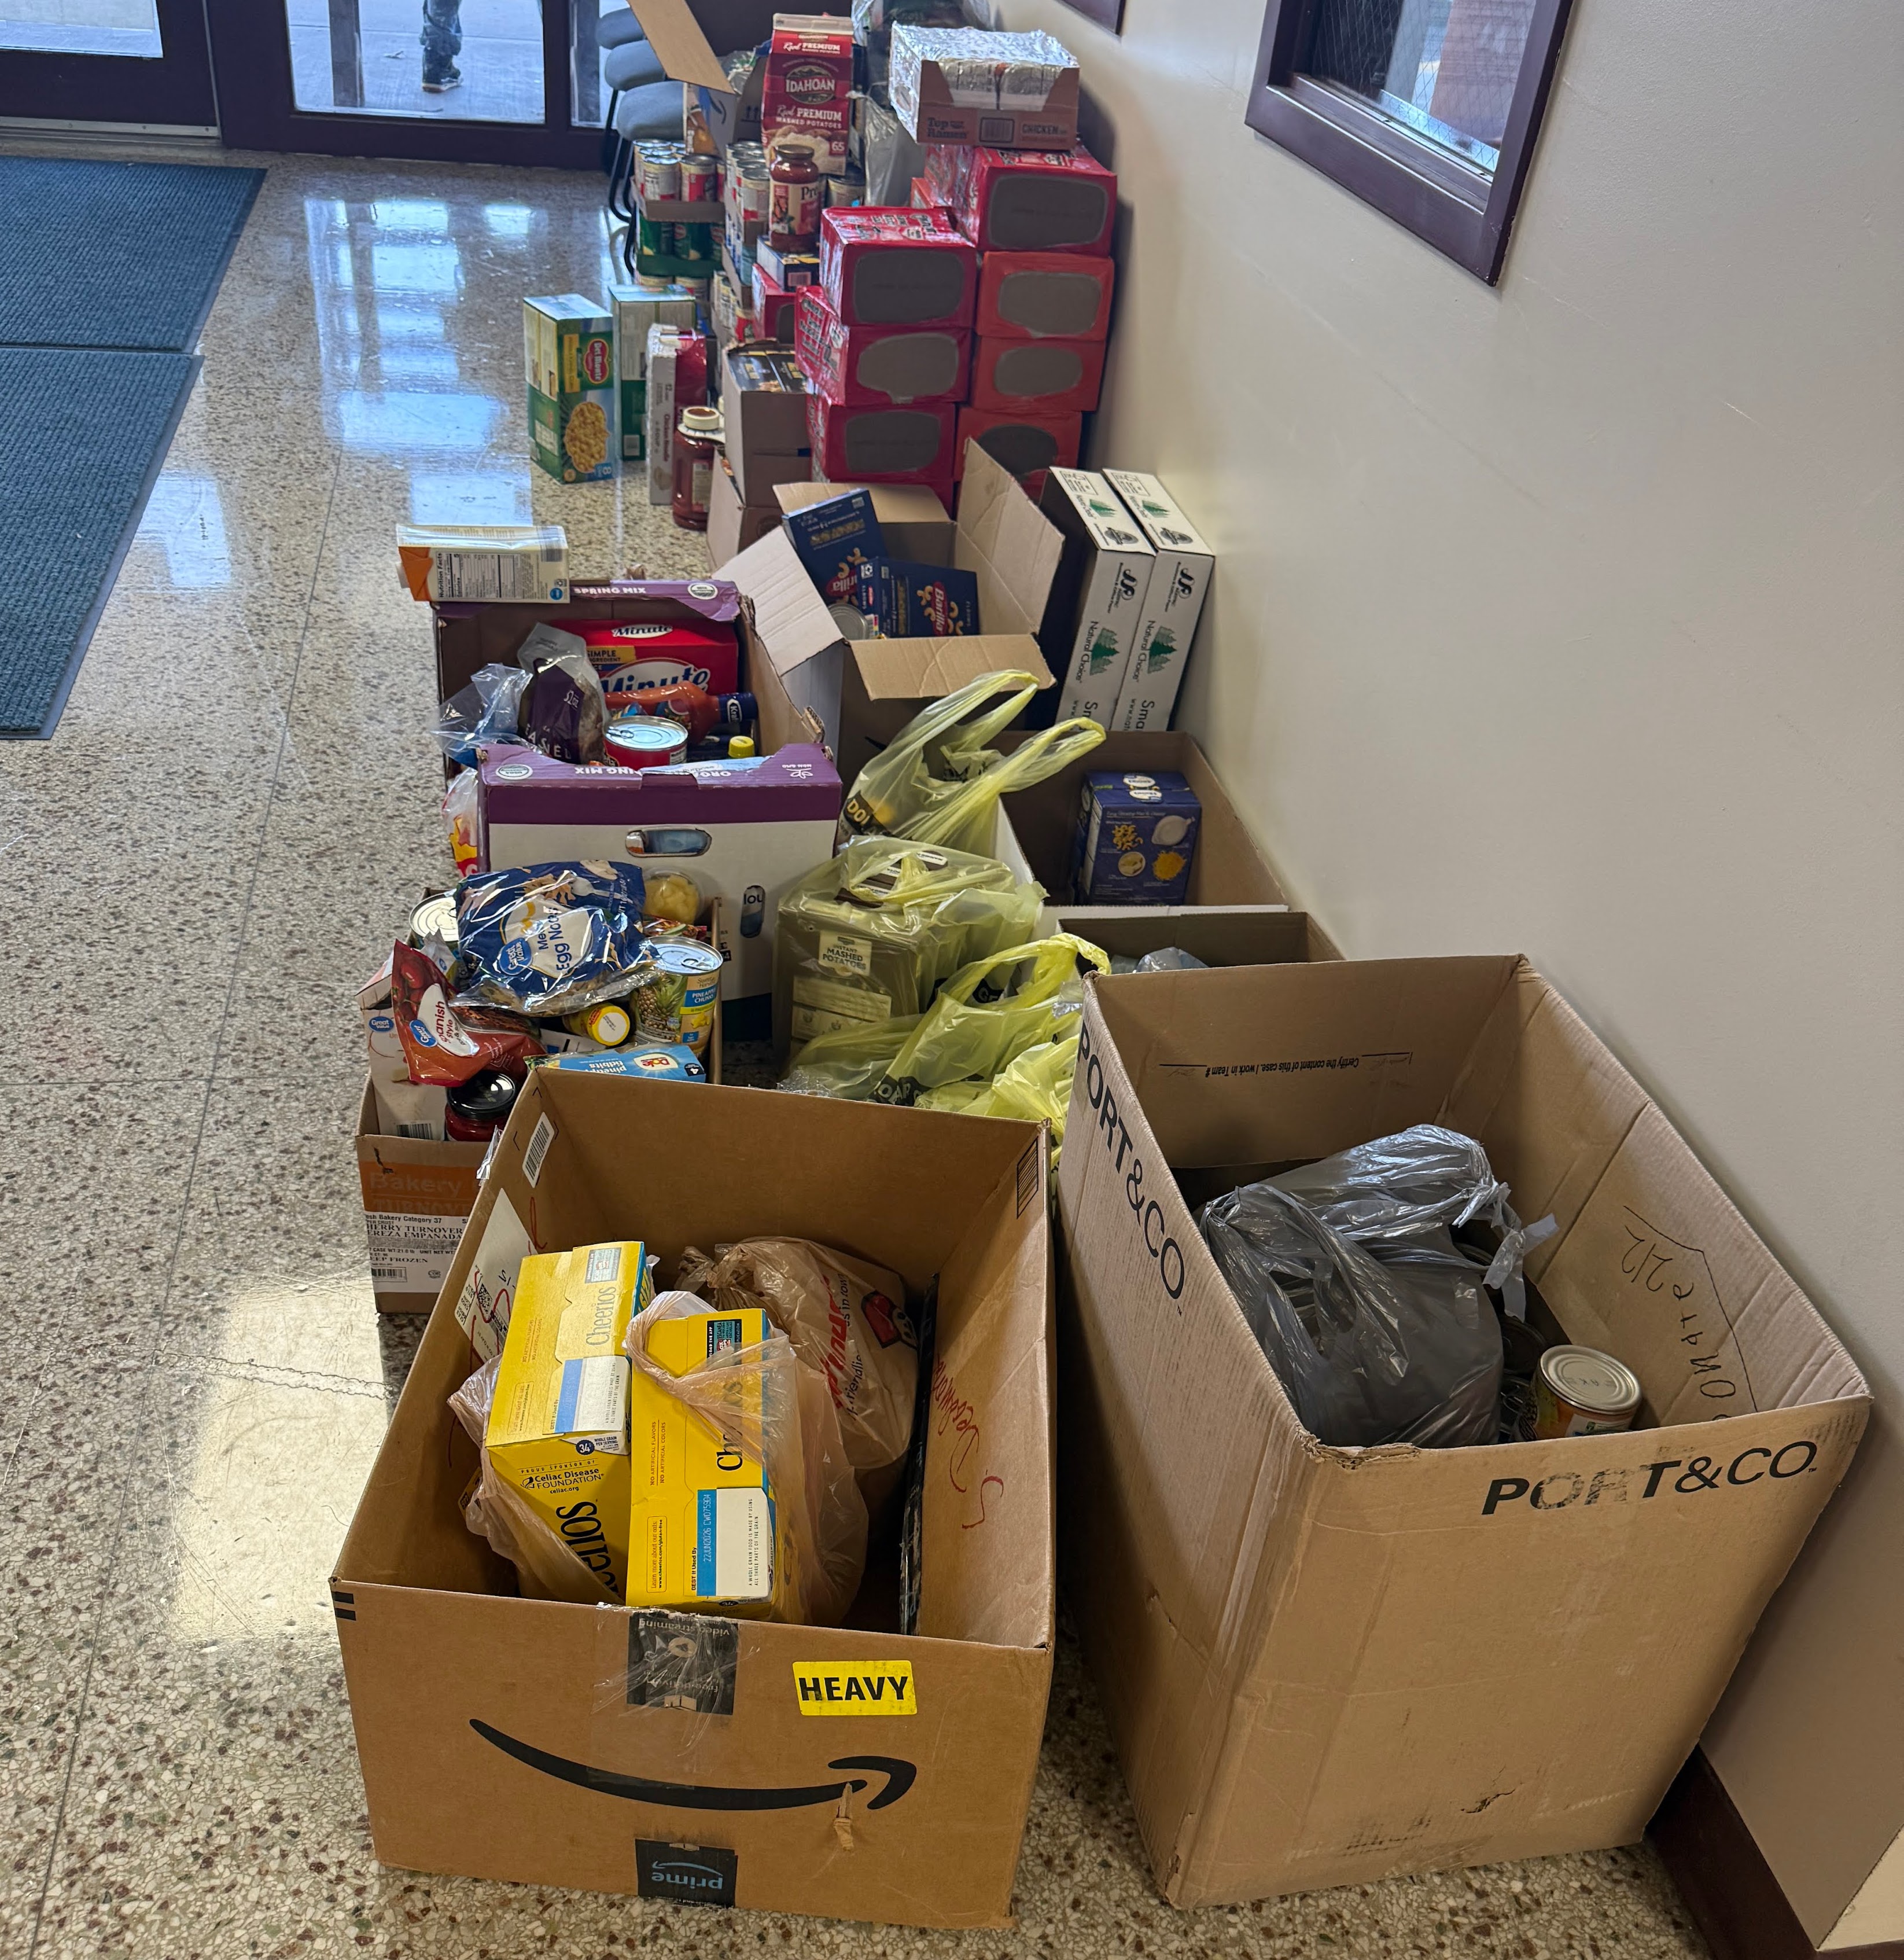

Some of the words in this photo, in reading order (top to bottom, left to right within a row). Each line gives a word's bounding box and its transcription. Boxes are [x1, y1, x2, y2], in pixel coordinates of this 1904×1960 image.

[786, 79, 835, 93] IDAHOAN
[797, 108, 841, 121] PREMIUM
[807, 120, 842, 128] POTATOES
[1023, 124, 1059, 134] CHICKEN
[935, 588, 945, 633] Barilla
[613, 624, 673, 636] Minute
[1140, 620, 1156, 652] Natural
[1082, 621, 1099, 652] Natural
[1076, 653, 1089, 681] Choice
[1133, 653, 1147, 681] Choice
[574, 767, 603, 775] MIX
[506, 944, 518, 970] Great
[515, 942, 525, 961] Value
[554, 942, 572, 970] Egg
[827, 947, 863, 962] MASHED
[822, 954, 866, 970] POTATOES
[643, 1058, 671, 1067] Dole
[1260, 1063, 1277, 1072] case.
[1279, 1062, 1291, 1073] this
[1291, 1060, 1299, 1072] of
[1300, 1060, 1325, 1071] content
[1326, 1059, 1337, 1069] the
[1338, 1056, 1359, 1068] Certify
[1212, 1066, 1229, 1077] Team
[1231, 1065, 1238, 1076] in
[1239, 1065, 1255, 1075] work
[370, 1172, 463, 1198] Bakery
[405, 1226, 463, 1234] TURNOVER
[585, 1286, 617, 1346] Cheerios
[579, 1444, 590, 1452] 34
[535, 1474, 563, 1483] Celiac
[564, 1468, 599, 1478] Disease
[537, 1474, 602, 1489] FOUNDATION
[650, 1476, 656, 1485] NO
[660, 1474, 666, 1483] NO
[550, 1486, 580, 1494] celiac.org
[703, 1527, 712, 1562] 22JUN2026
[699, 1627, 730, 1637] video
[798, 1675, 909, 1702] HEAVY
[651, 1872, 723, 1890] prime
